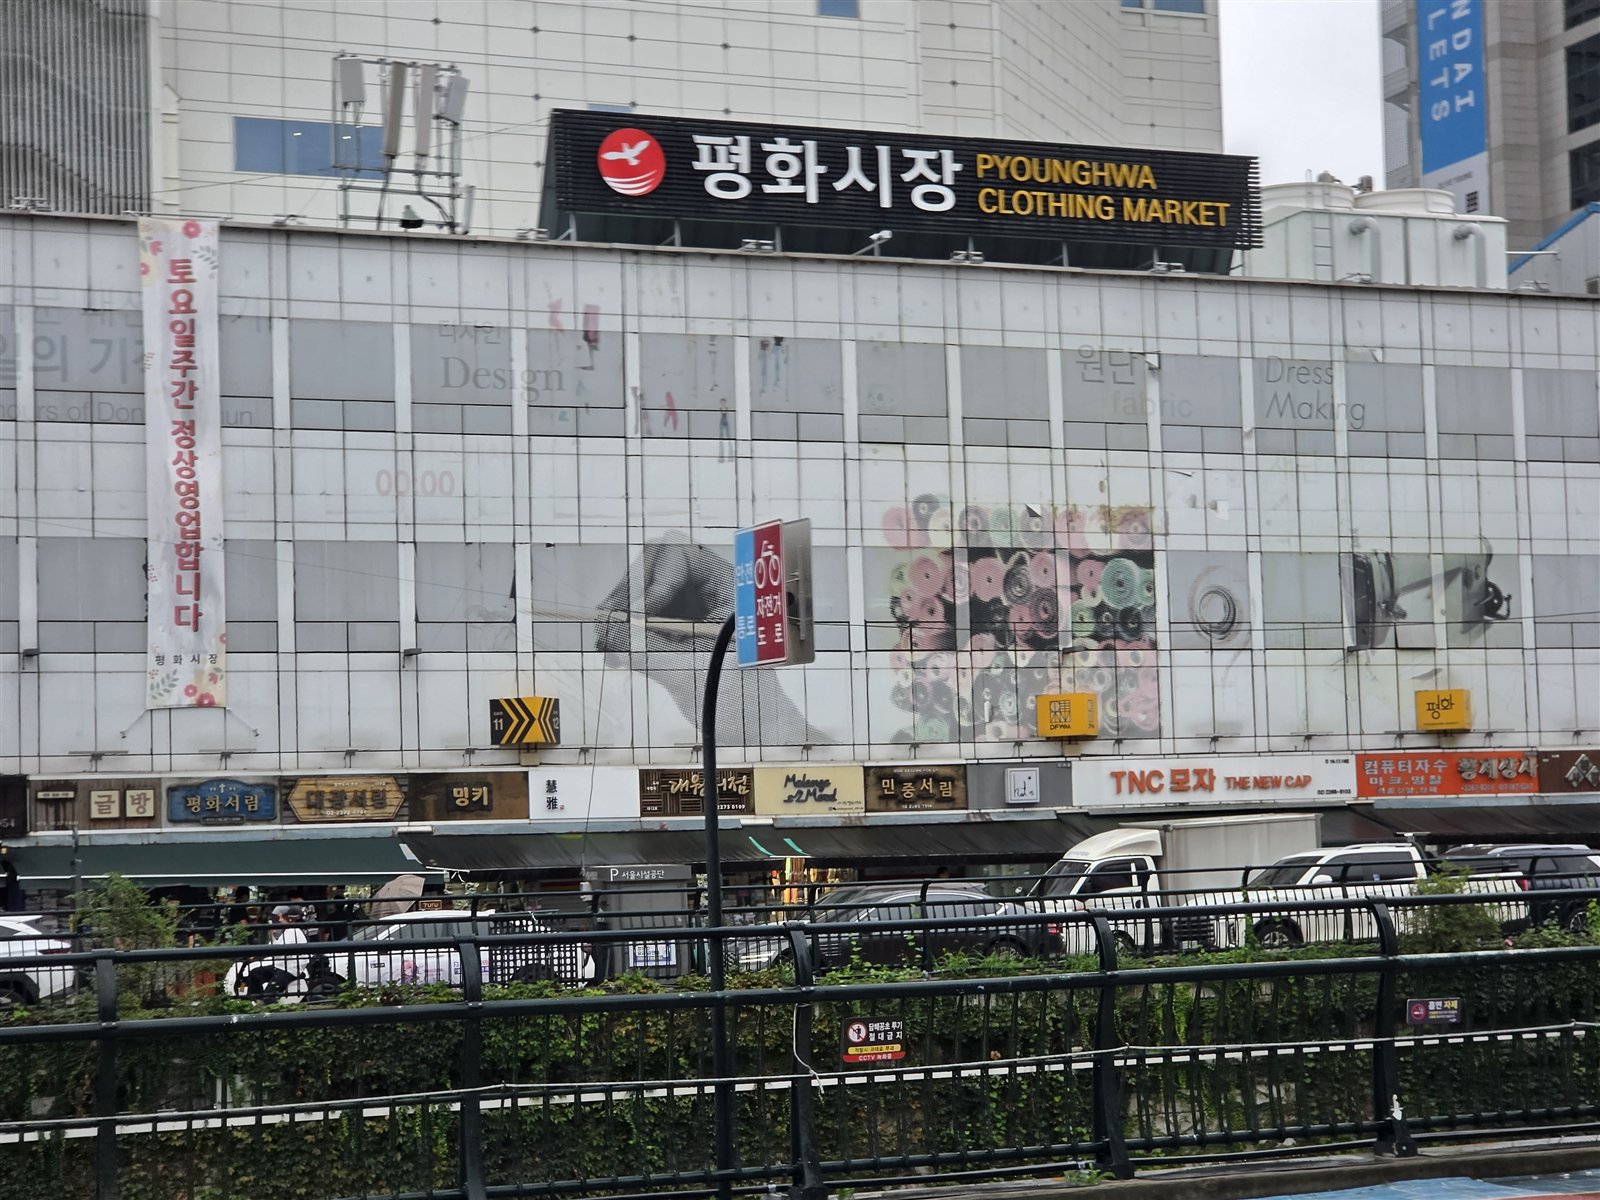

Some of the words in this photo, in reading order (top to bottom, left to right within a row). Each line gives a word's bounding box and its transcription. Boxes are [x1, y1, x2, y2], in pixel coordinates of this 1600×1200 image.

[691, 132, 966, 213] 평화시장
[975, 151, 1157, 191] PYOUNGHWA
[977, 186, 1115, 222] CLOTHING
[1120, 198, 1230, 228] MARKET
[440, 356, 566, 402] Design
[1075, 344, 1138, 386] 원단
[1264, 355, 1334, 385] Dress
[1111, 390, 1195, 419] fabric
[1265, 388, 1366, 430] Making
[756, 591, 782, 619] 자전거
[154, 654, 218, 666] 평화시장
[493, 718, 504, 731] 11
[1363, 758, 1448, 775] 컴퓨터자수
[545, 779, 559, 810] 慧雅
[882, 777, 952, 799] 민중서림
[1110, 770, 1165, 795] TNC
[1169, 768, 1216, 792] 모자
[1223, 775, 1251, 790] THE
[1252, 774, 1282, 790] NEW
[1284, 774, 1312, 789] CAP
[185, 794, 259, 813] 평화서림
[452, 786, 489, 807] 밍키
[610, 868, 619, 882] P
[621, 869, 665, 880] 서울시설공단
[891, 1020, 903, 1030] 투기
